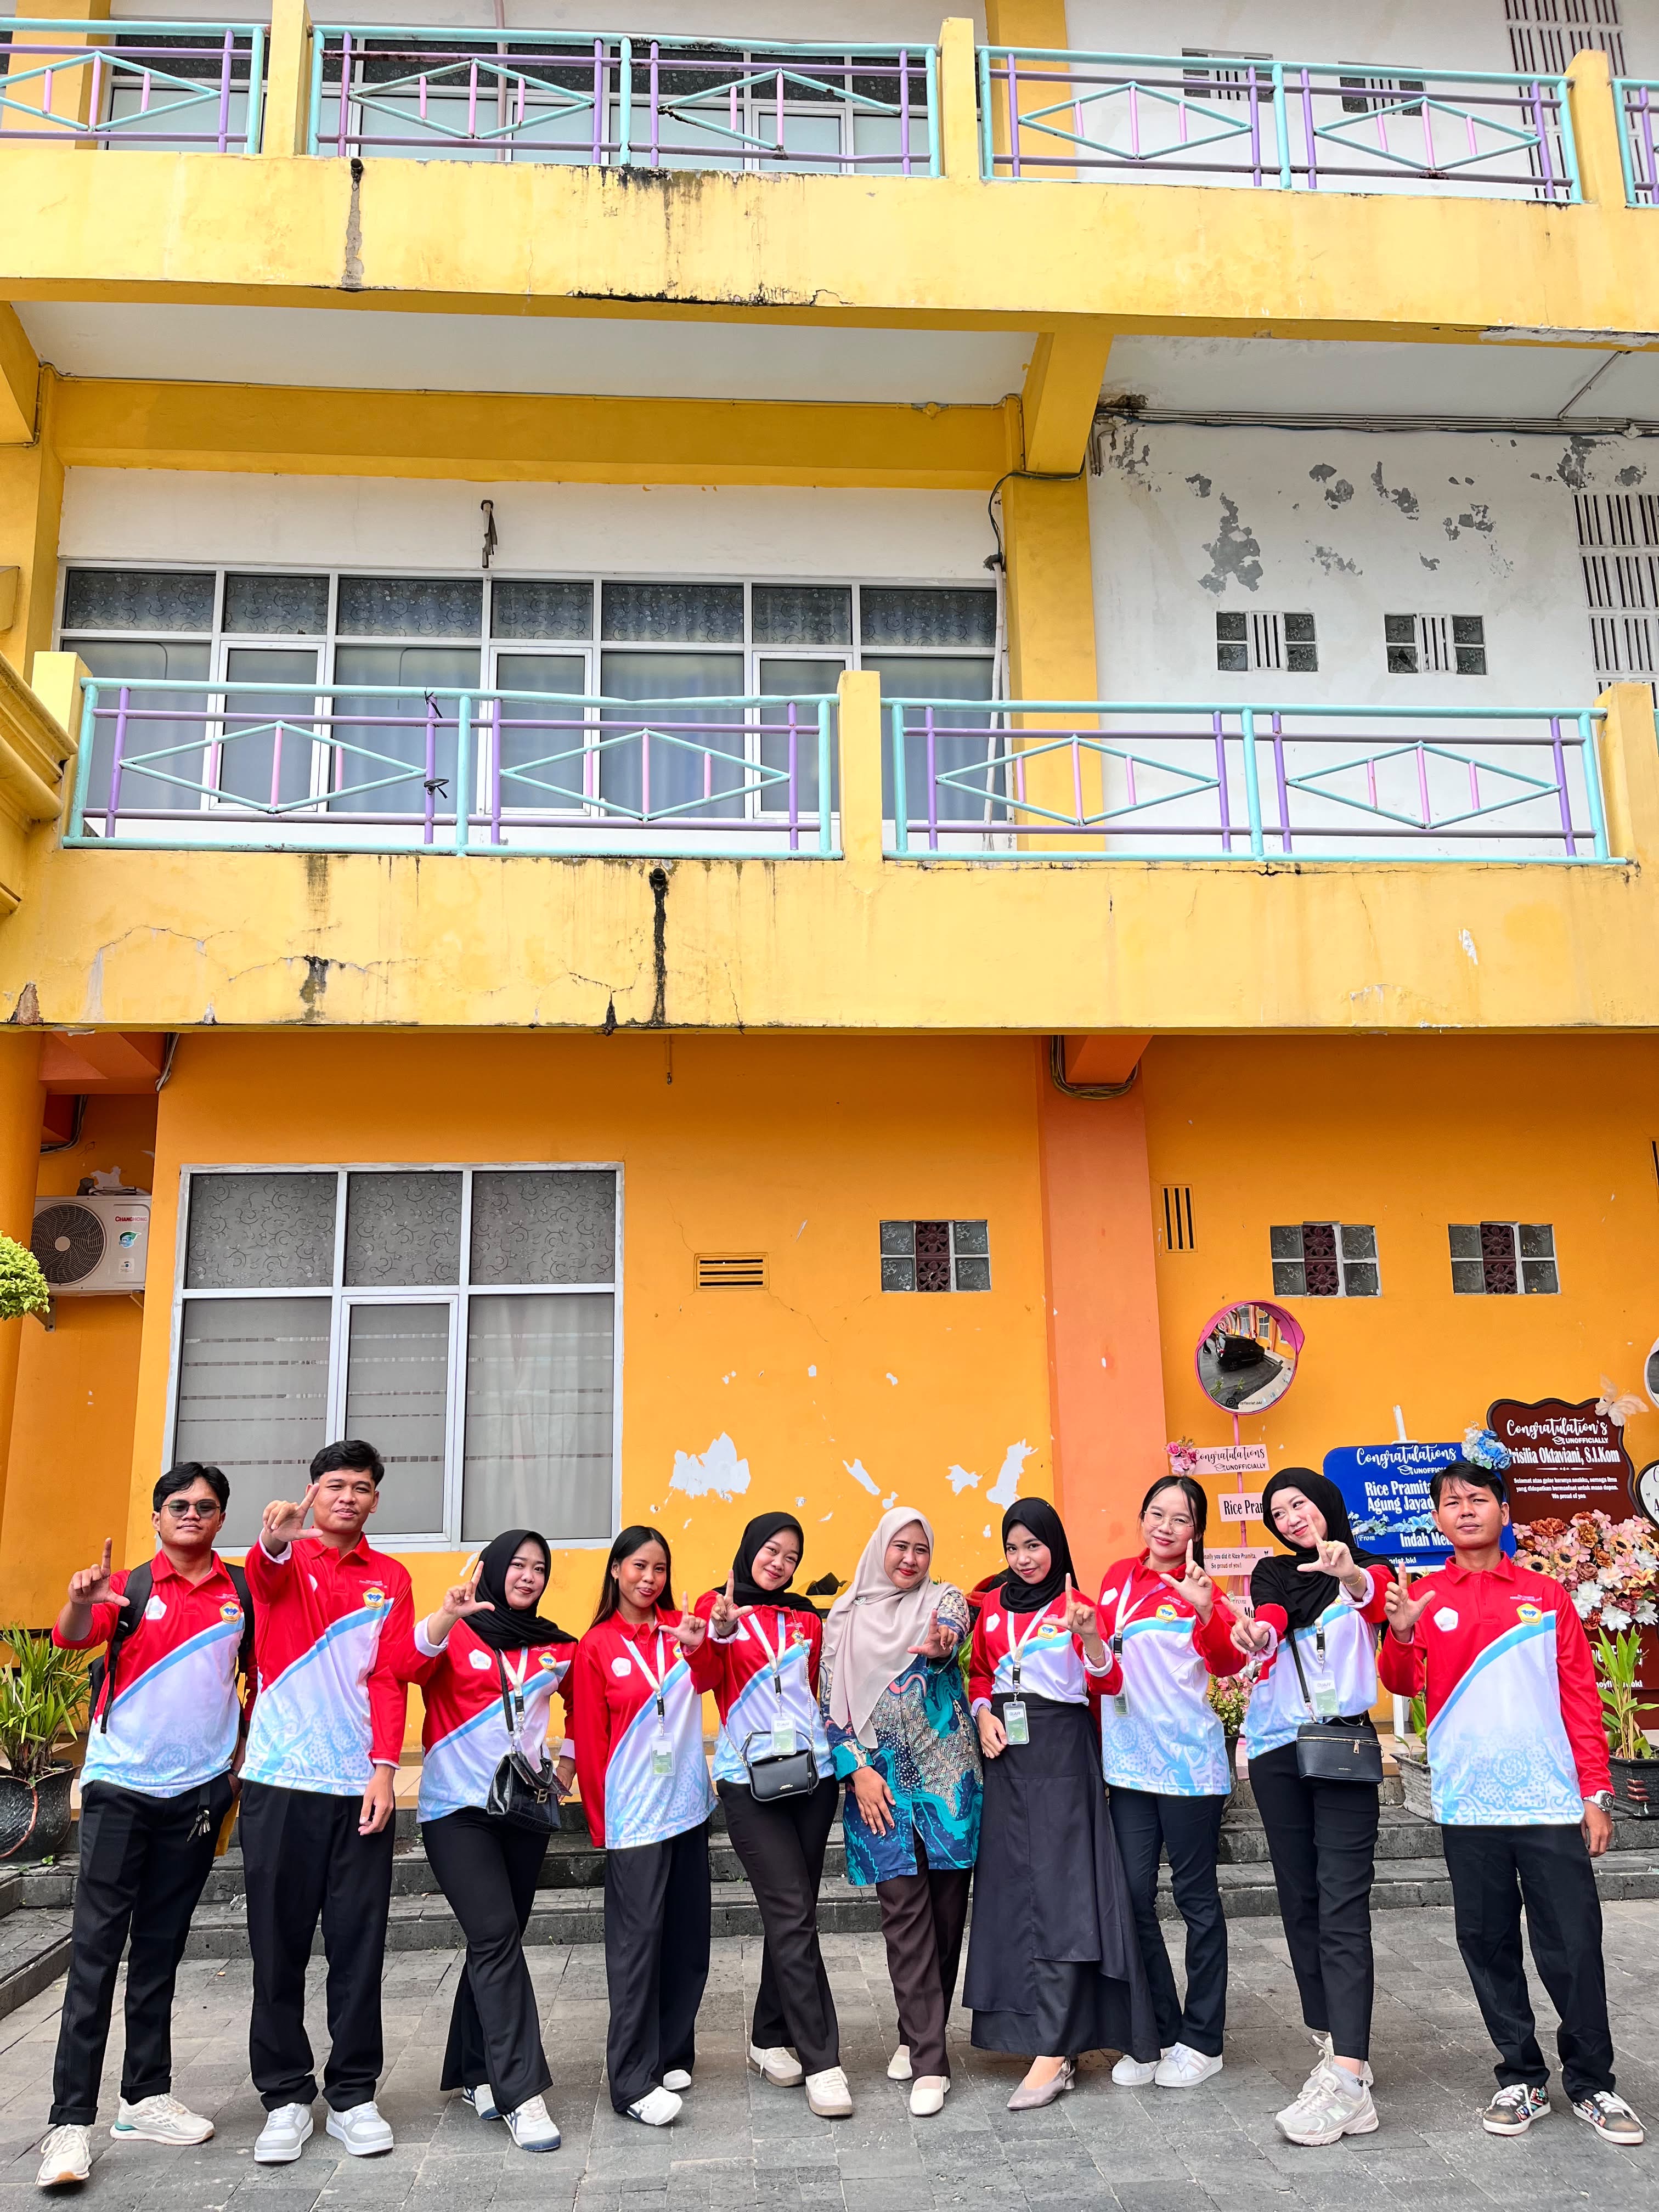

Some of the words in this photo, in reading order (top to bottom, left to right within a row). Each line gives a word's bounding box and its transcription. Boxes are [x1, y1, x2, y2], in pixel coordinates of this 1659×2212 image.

[1506, 1417, 1607, 1440] Congratulation's
[1356, 1443, 1457, 1469] Congratulations
[1538, 1446, 1584, 1465] Oktaviani,
[1584, 1446, 1621, 1464] S.I.Kom
[1364, 1481, 1390, 1497] Rice
[1223, 1500, 1243, 1515] Rice
[1368, 1496, 1402, 1514] Agung
[1400, 1531, 1430, 1548] Indah
